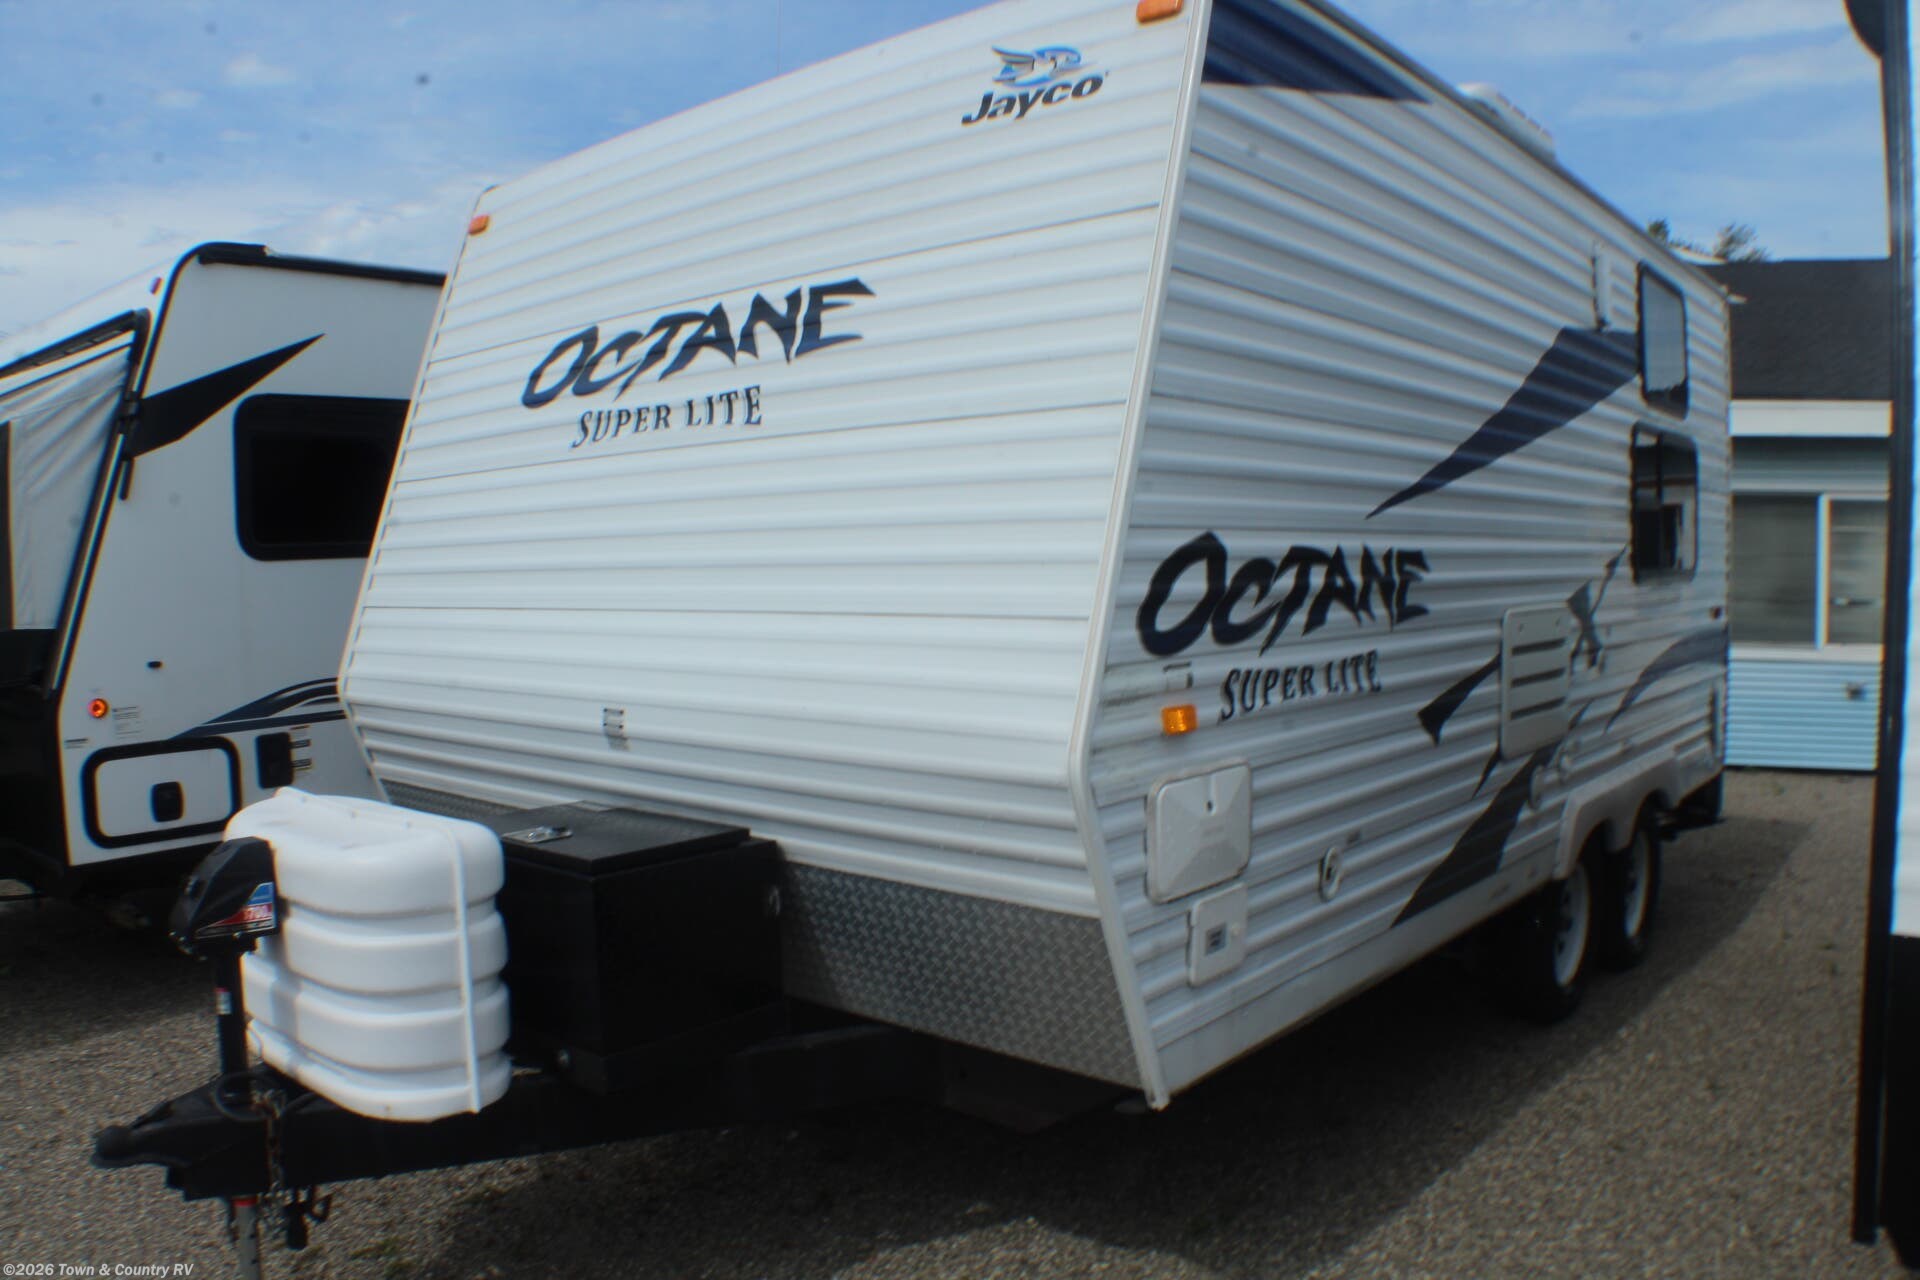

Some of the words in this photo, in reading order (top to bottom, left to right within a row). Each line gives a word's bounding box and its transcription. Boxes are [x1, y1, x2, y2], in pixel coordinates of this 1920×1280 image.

[961, 75, 1104, 126] Jayco
[521, 277, 877, 409] OCTANE
[571, 404, 671, 448] SUPER
[686, 385, 762, 427] LITE
[1136, 530, 1431, 657] OCTANE
[1217, 662, 1316, 726] SUPER
[1325, 649, 1382, 694] LITE
